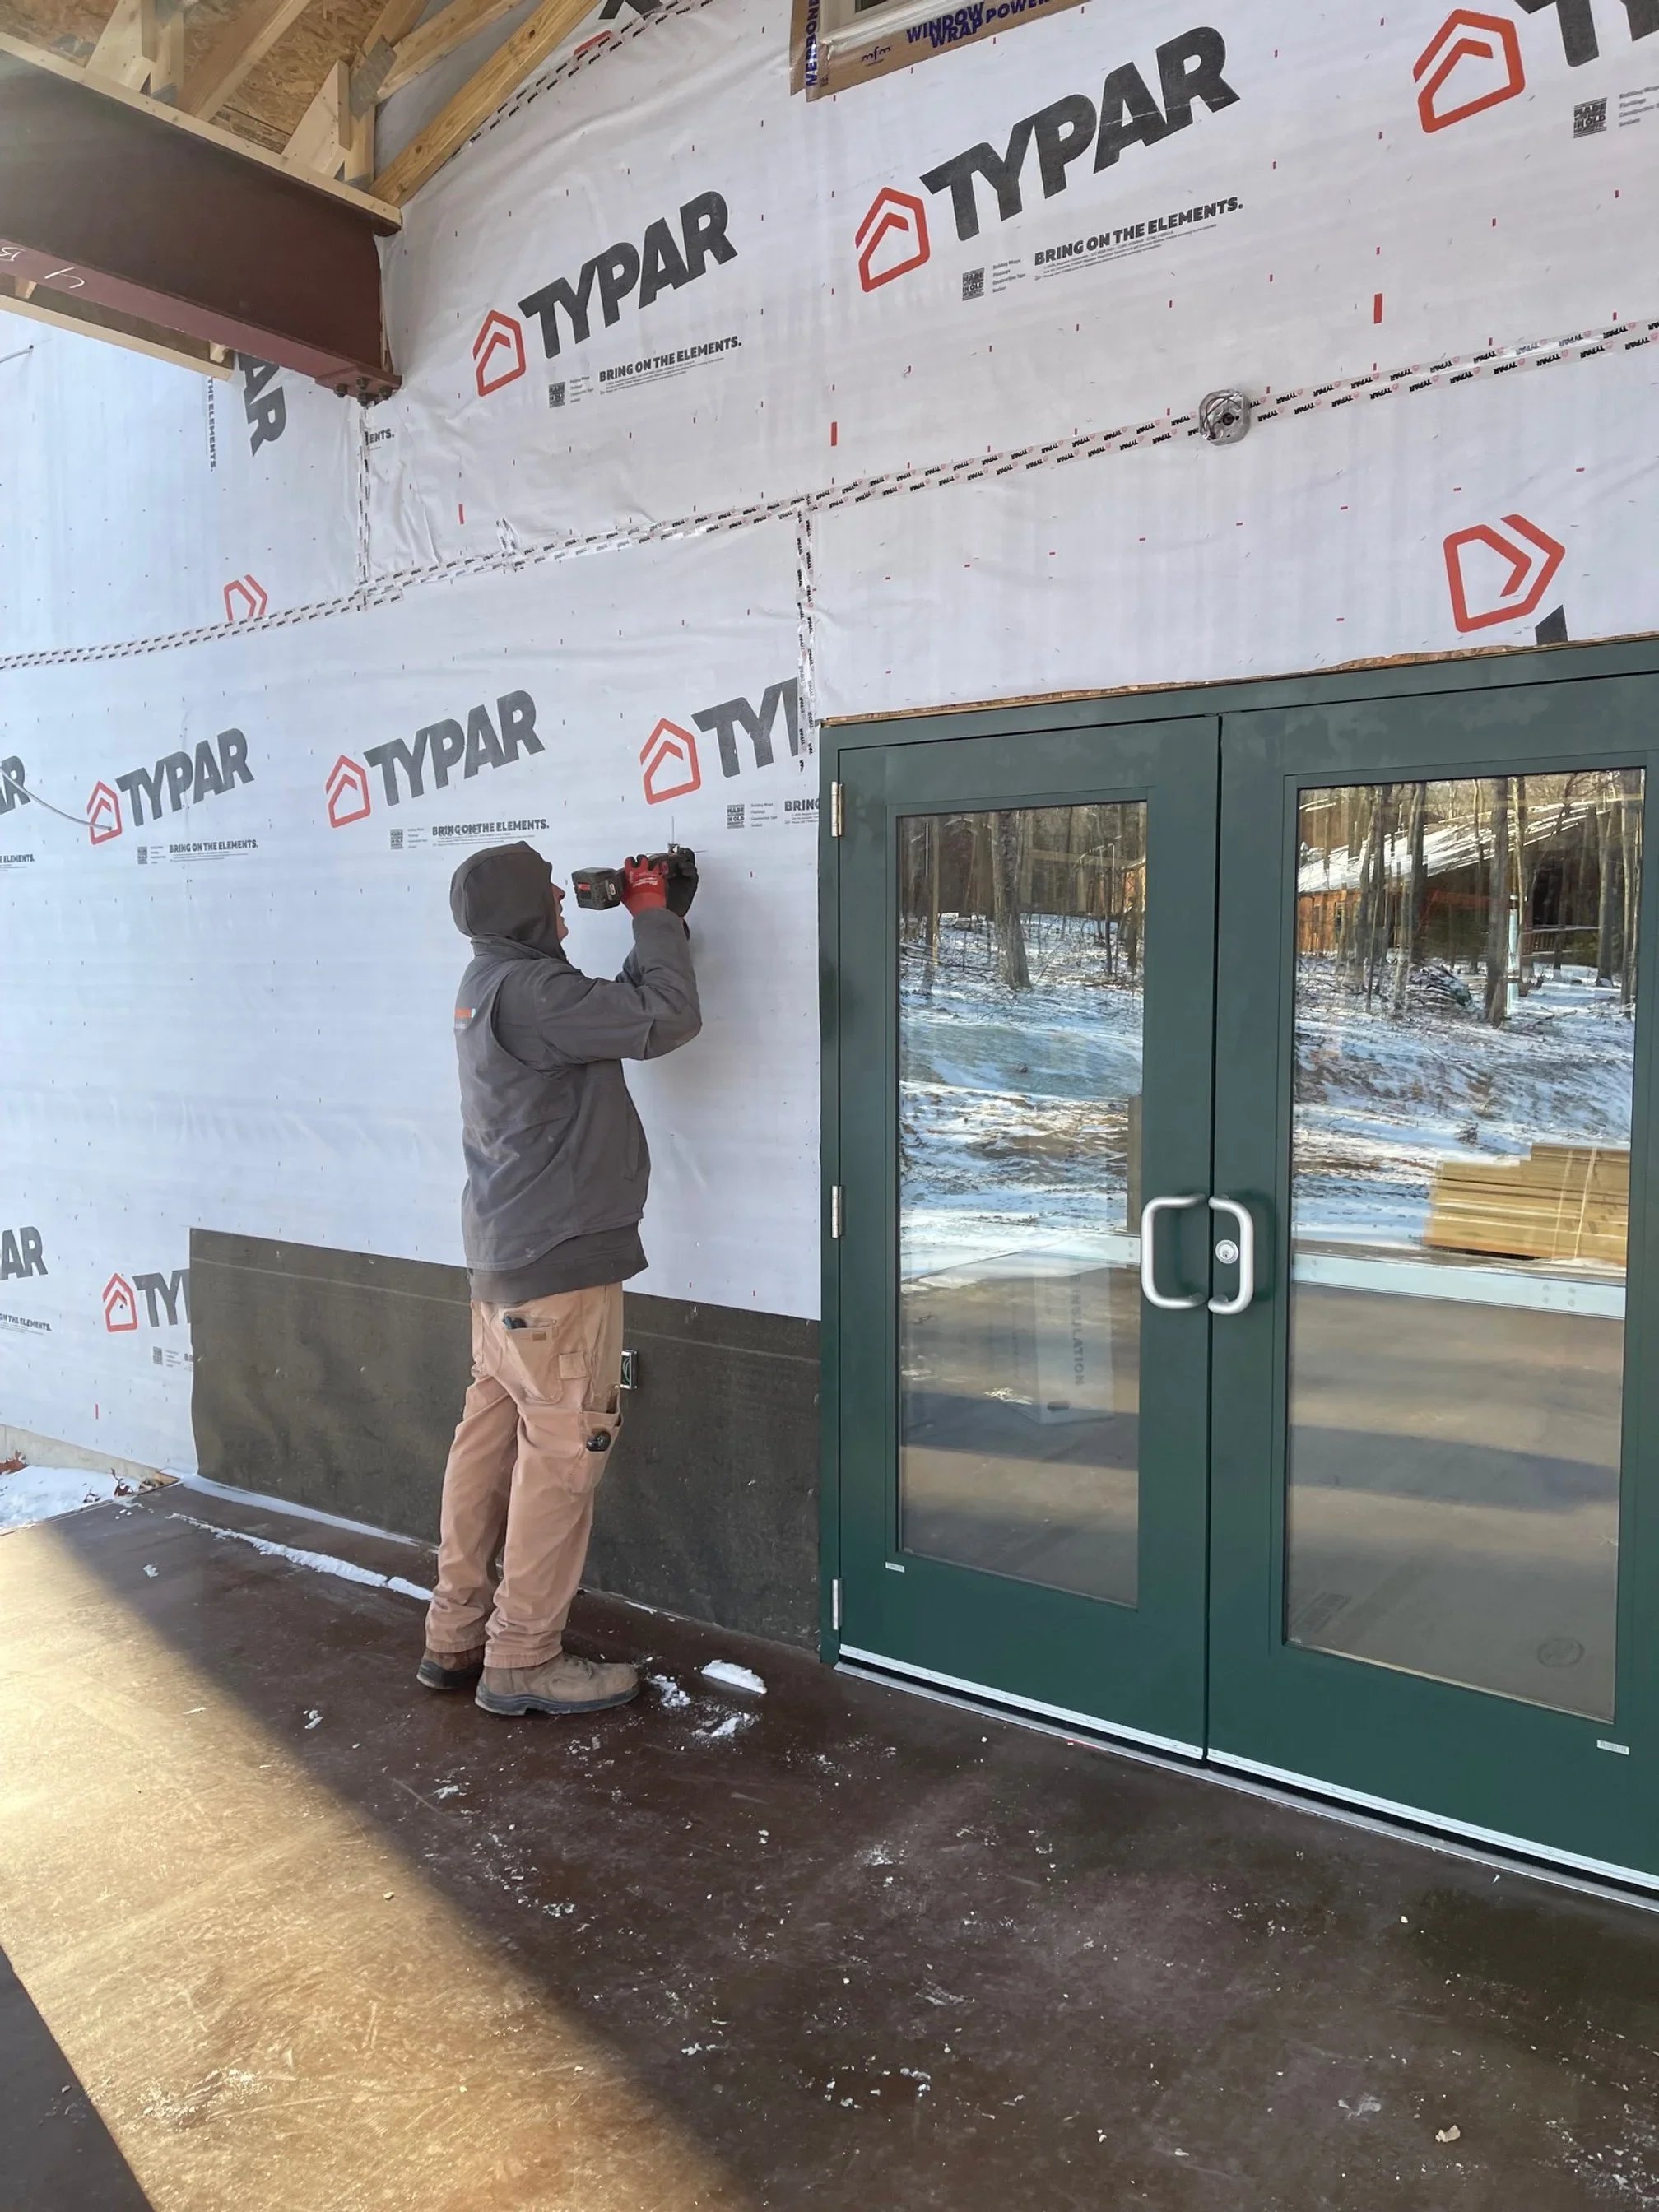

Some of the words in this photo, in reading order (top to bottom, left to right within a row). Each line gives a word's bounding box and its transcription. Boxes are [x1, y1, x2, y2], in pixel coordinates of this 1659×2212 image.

[906, 2, 984, 44] WINDOW
[930, 16, 983, 49] WRAP
[919, 26, 1241, 241] TYPAR
[1034, 240, 1085, 266] BRING
[1086, 232, 1110, 251] ON
[1113, 222, 1145, 243] THE
[1147, 196, 1243, 234] ELEMENTS.
[517, 191, 738, 360] TYPAR
[599, 363, 634, 382] BRING
[635, 358, 652, 373] ON
[653, 352, 676, 368] THE
[676, 336, 741, 362] ELEMENTS.
[116, 728, 254, 826] TYPAR
[364, 690, 545, 806] TYPAR
[169, 843, 191, 853] BRING
[192, 842, 203, 851] ON
[203, 841, 217, 850] THE
[218, 839, 258, 850] ELEMENTS.
[432, 825, 461, 836] BRING
[476, 822, 495, 833] THE
[496, 819, 550, 832] ELEMENTS.
